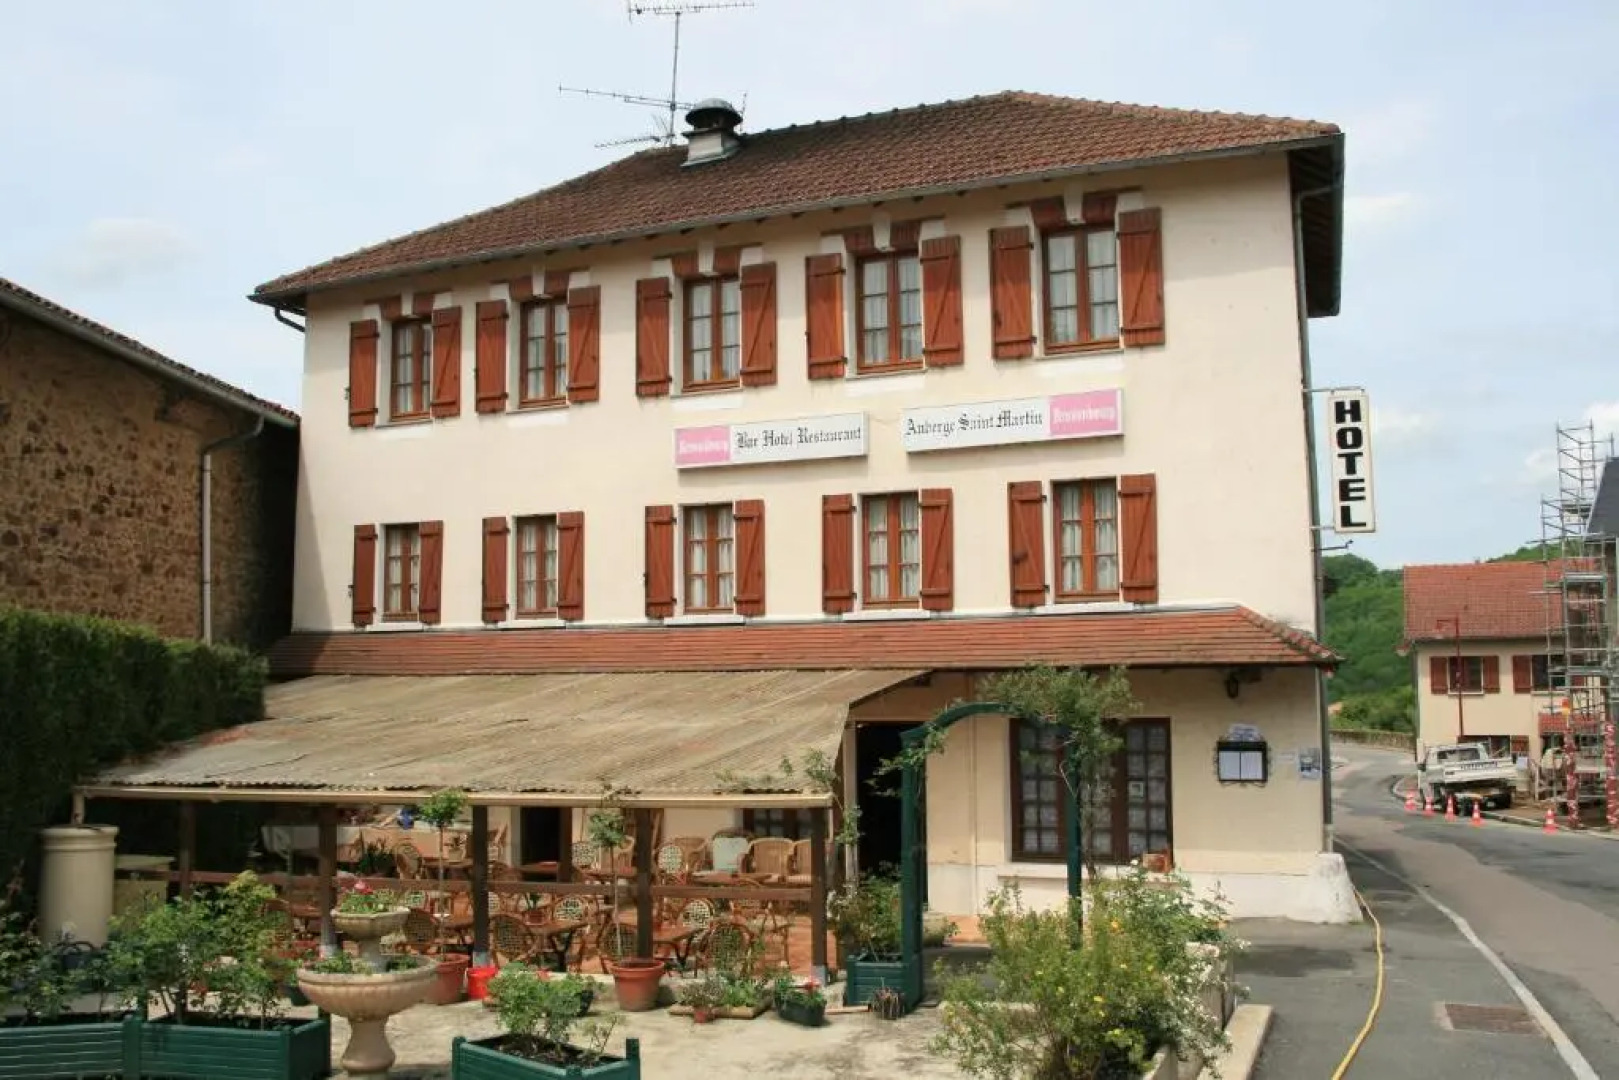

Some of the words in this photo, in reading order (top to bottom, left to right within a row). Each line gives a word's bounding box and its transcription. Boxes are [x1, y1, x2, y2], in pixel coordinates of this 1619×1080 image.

[736, 432, 758, 448] Bar
[762, 429, 793, 447] Hotel
[797, 426, 861, 444] Restaurant
[905, 418, 956, 437] Auberge
[958, 413, 994, 430] Saint
[996, 409, 1043, 428] Martin
[1334, 399, 1367, 528] HOTEL
